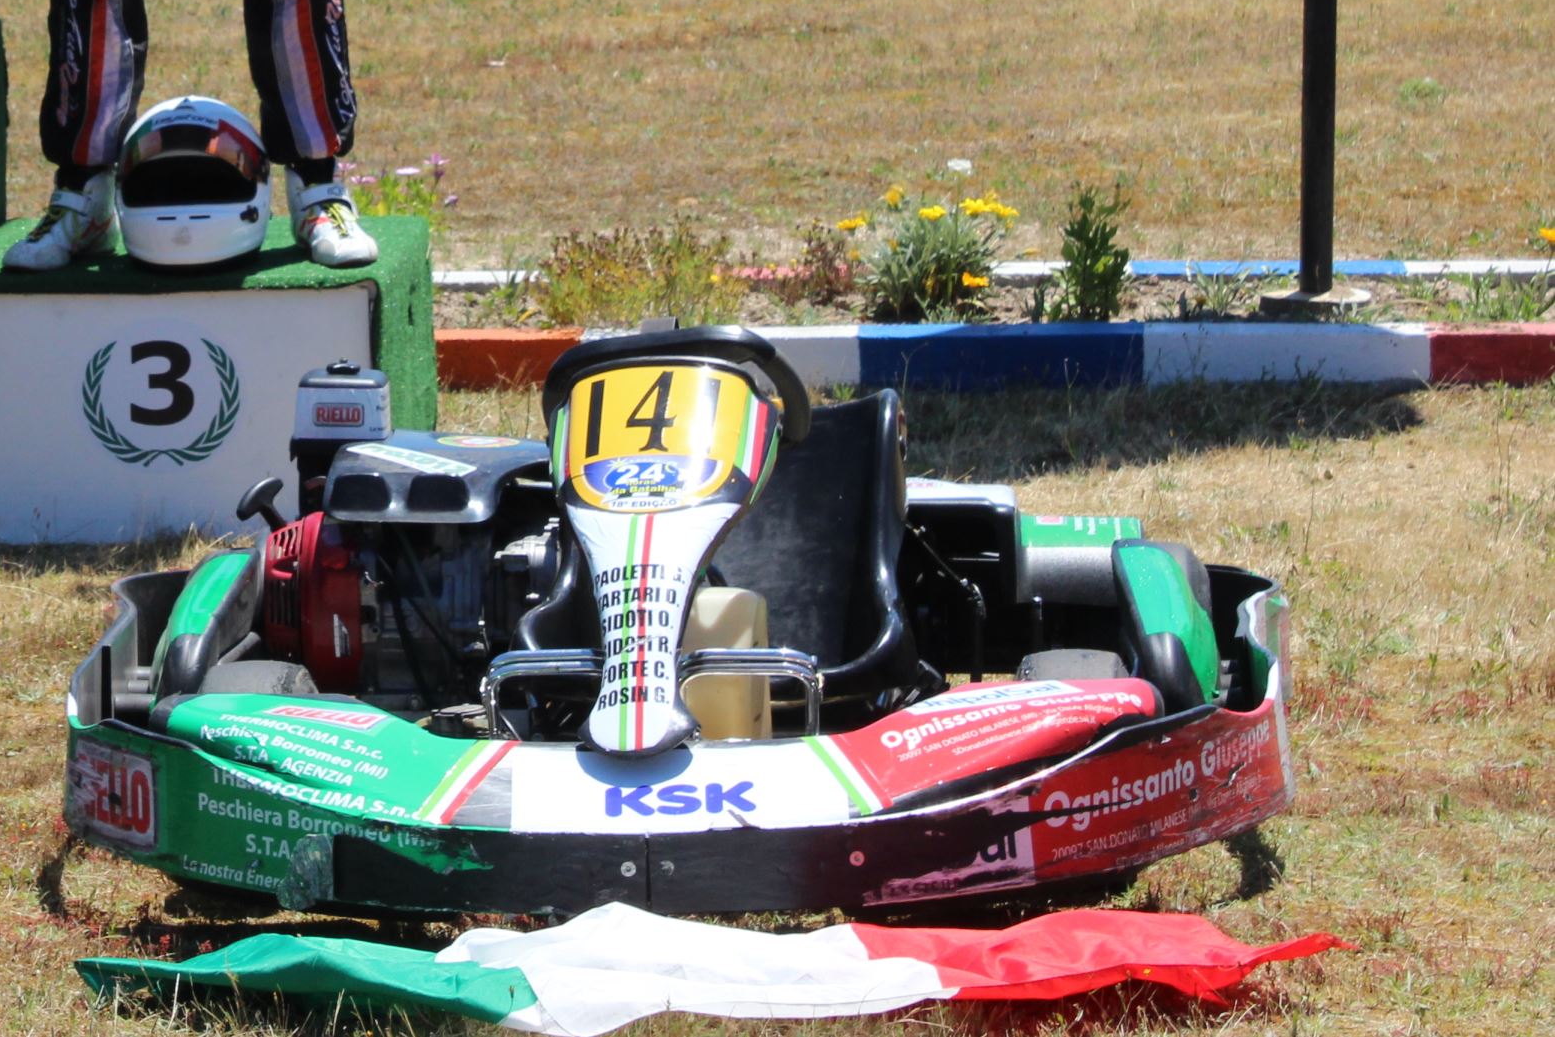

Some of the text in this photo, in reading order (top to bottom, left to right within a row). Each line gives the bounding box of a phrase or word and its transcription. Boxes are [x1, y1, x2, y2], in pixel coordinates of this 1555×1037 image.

[130, 340, 195, 426] 3
[316, 405, 362, 423] RIELLO
[614, 463, 666, 486] 24
[601, 610, 653, 636] SIDOTI
[605, 636, 673, 660] IDOTI R.
[653, 660, 670, 680] C.
[597, 686, 649, 711] ROSIN
[272, 707, 377, 726] RIELLO
[880, 691, 1143, 750] Ognissanto Giuseppe
[220, 713, 384, 760] THERMOCLIMA S.n.c.
[923, 740, 943, 754] SAN
[942, 729, 979, 748] DONATO
[200, 723, 389, 780] Peschiera Borromeo (MI)
[280, 756, 354, 787] AGENZIA
[1043, 717, 1271, 832] Ognissanto Giuseppe
[197, 792, 283, 827] Peschiera
[605, 780, 757, 818] KSK
[1085, 836, 1108, 852] SAN
[199, 859, 244, 884] nostra
